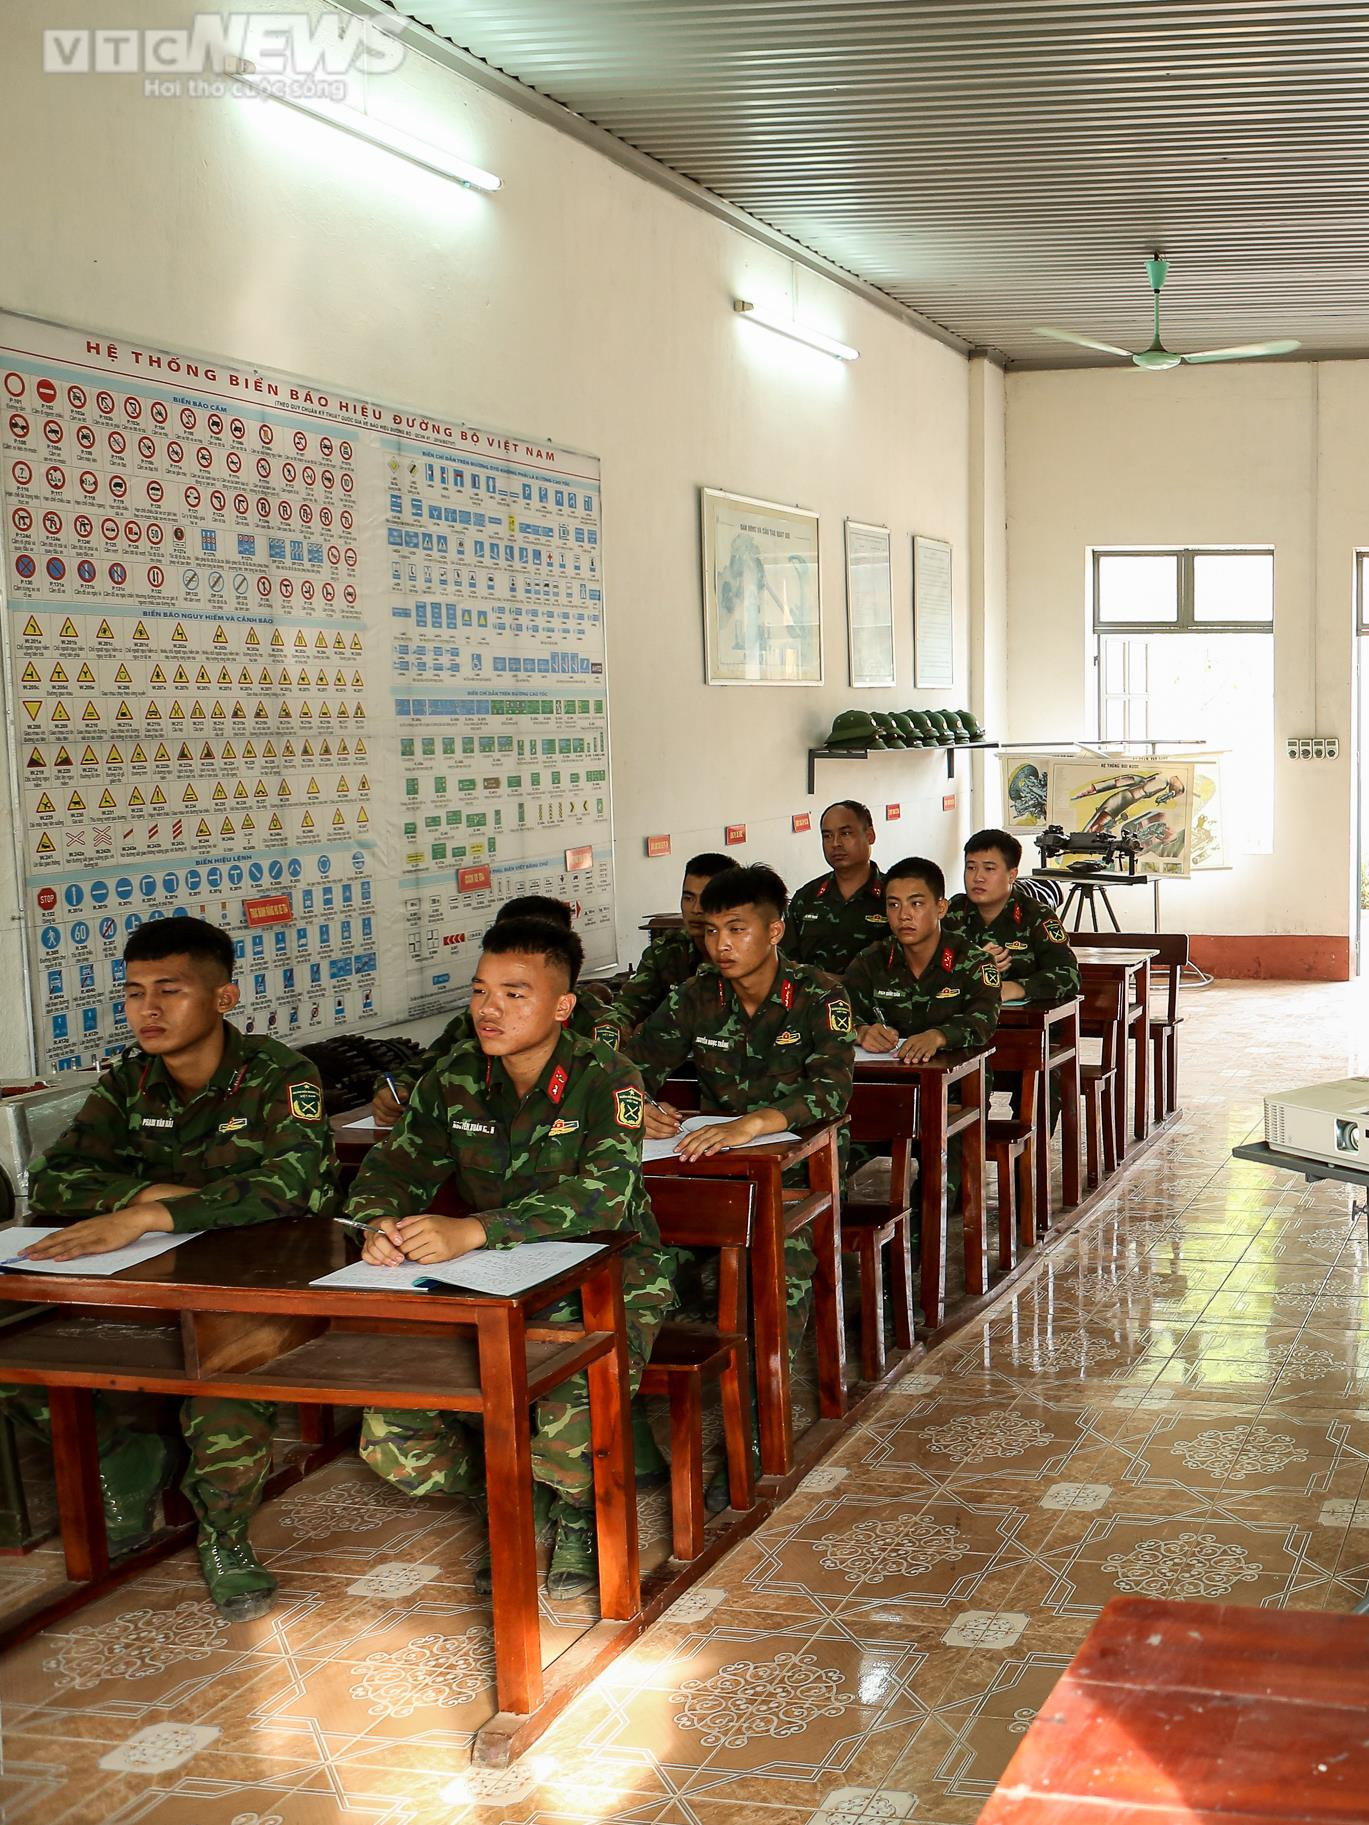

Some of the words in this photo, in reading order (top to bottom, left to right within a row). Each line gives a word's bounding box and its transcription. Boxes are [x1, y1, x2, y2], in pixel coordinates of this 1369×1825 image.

[86, 341, 118, 362] HỆ
[131, 351, 217, 381] THỐNG
[229, 374, 279, 396] BIỂN
[290, 389, 329, 408] BÁO
[339, 401, 382, 420] HIỆU
[392, 414, 453, 437] ĐƯỜNG
[461, 431, 480, 447] BỘ
[487, 437, 519, 454] VIỆT
[526, 447, 555, 462] NAM
[193, 401, 209, 409] BÁO
[209, 403, 228, 413] CẤM
[274, 400, 291, 410] (THEO
[290, 404, 301, 412] QUY
[143, 609, 161, 618] BIỂN
[162, 610, 181, 619] BÁO
[205, 613, 224, 621] HIỂM
[225, 614, 236, 622] VÀ
